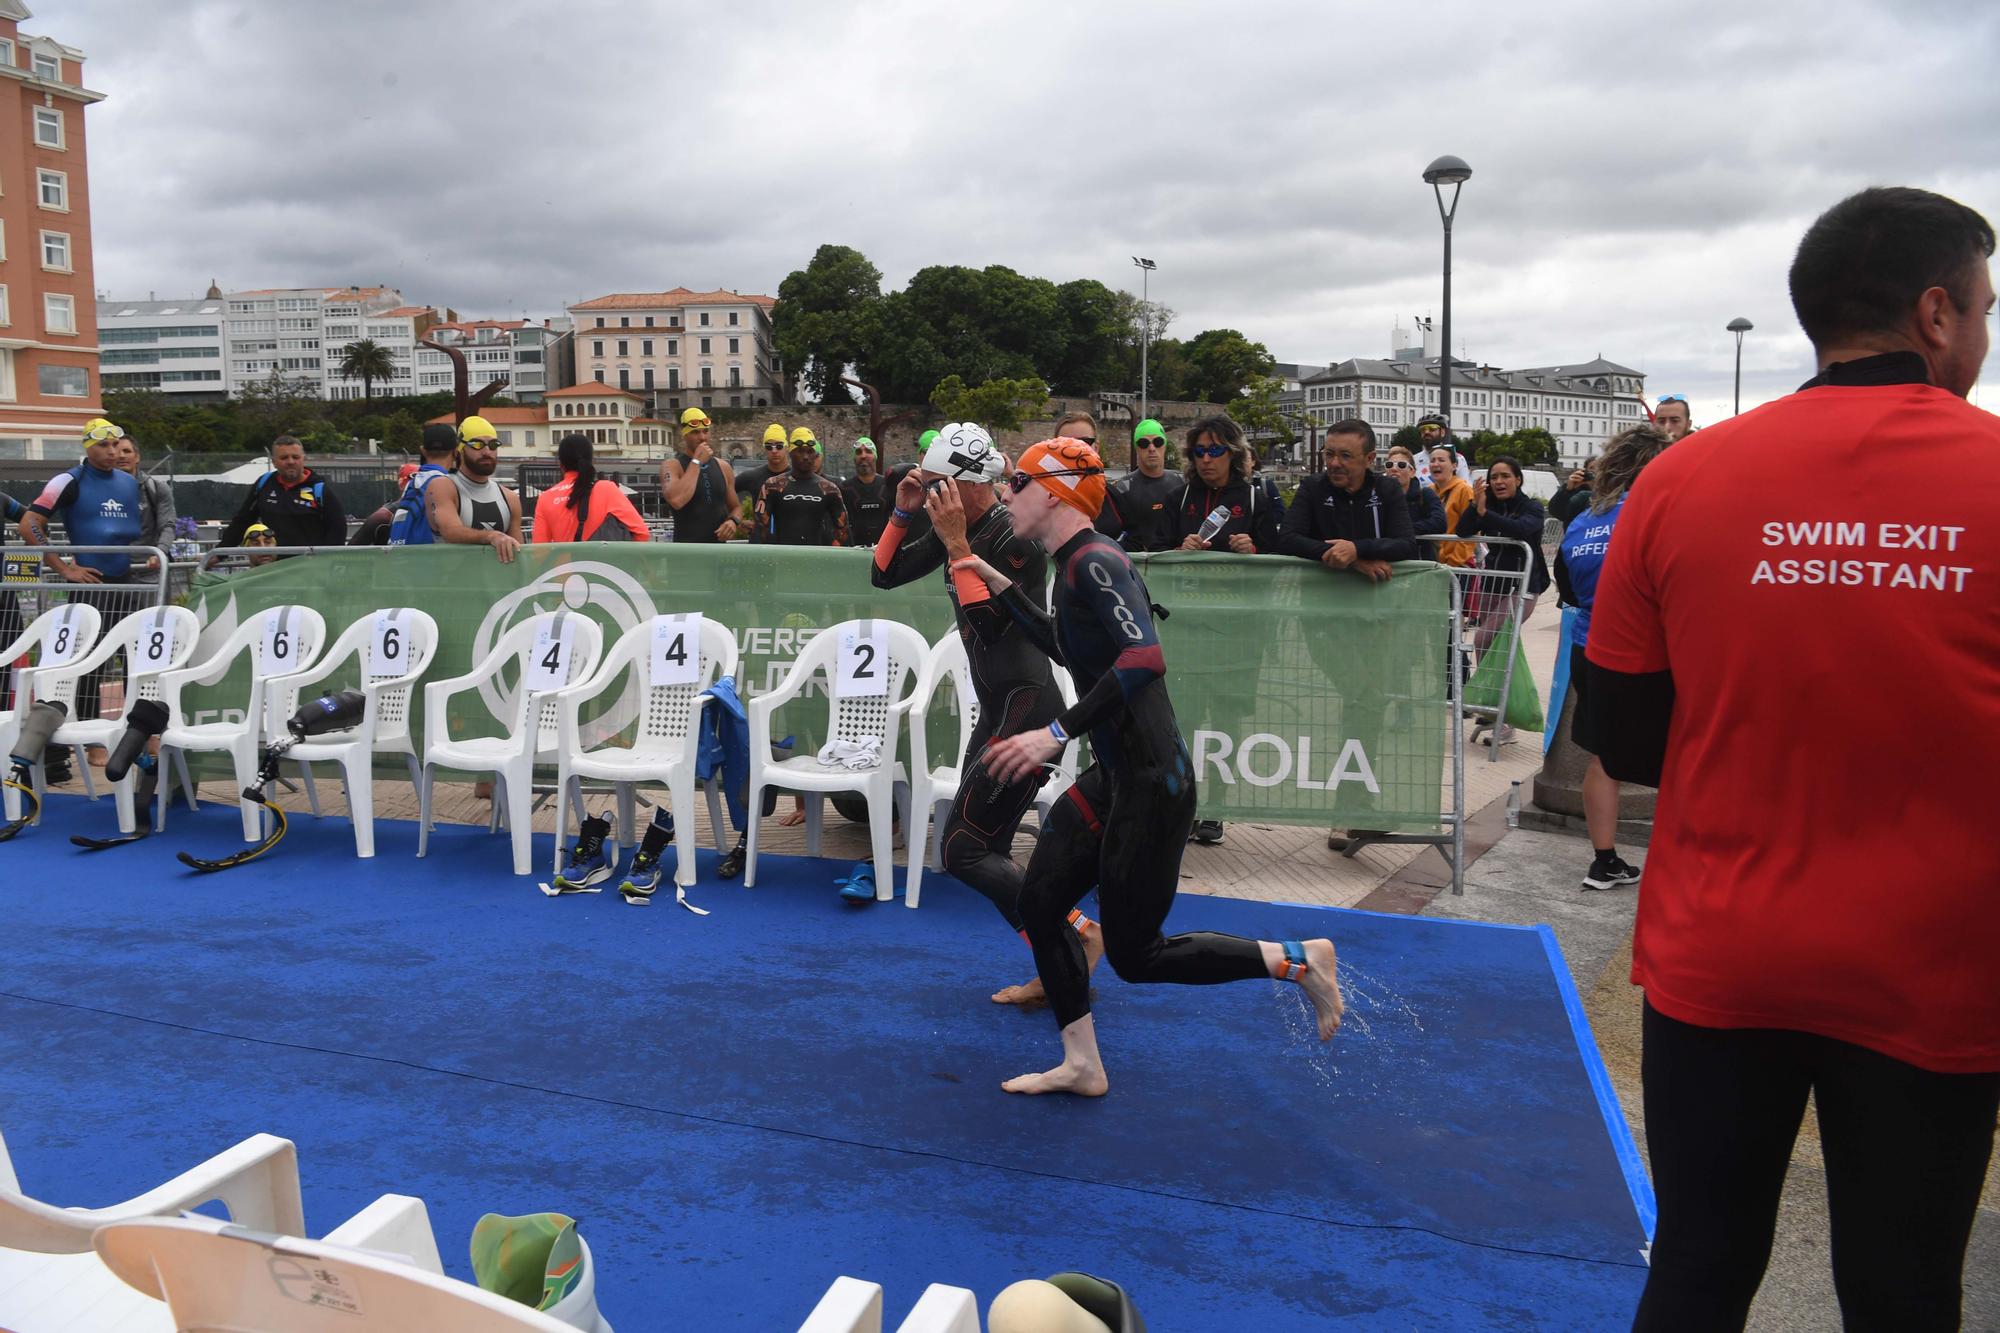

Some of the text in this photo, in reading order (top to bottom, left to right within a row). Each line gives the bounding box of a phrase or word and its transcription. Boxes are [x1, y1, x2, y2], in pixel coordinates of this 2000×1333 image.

[1761, 521, 1966, 552] SWIM EXIT
[1750, 559, 1974, 593] ASSISTANT
[54, 626, 70, 655] 8
[148, 631, 165, 660] 8
[273, 631, 289, 659] 6
[383, 627, 400, 660] 6
[665, 632, 688, 667] 4
[541, 642, 561, 675] 4
[852, 644, 875, 679] 2
[1193, 729, 1381, 793] ROLA
